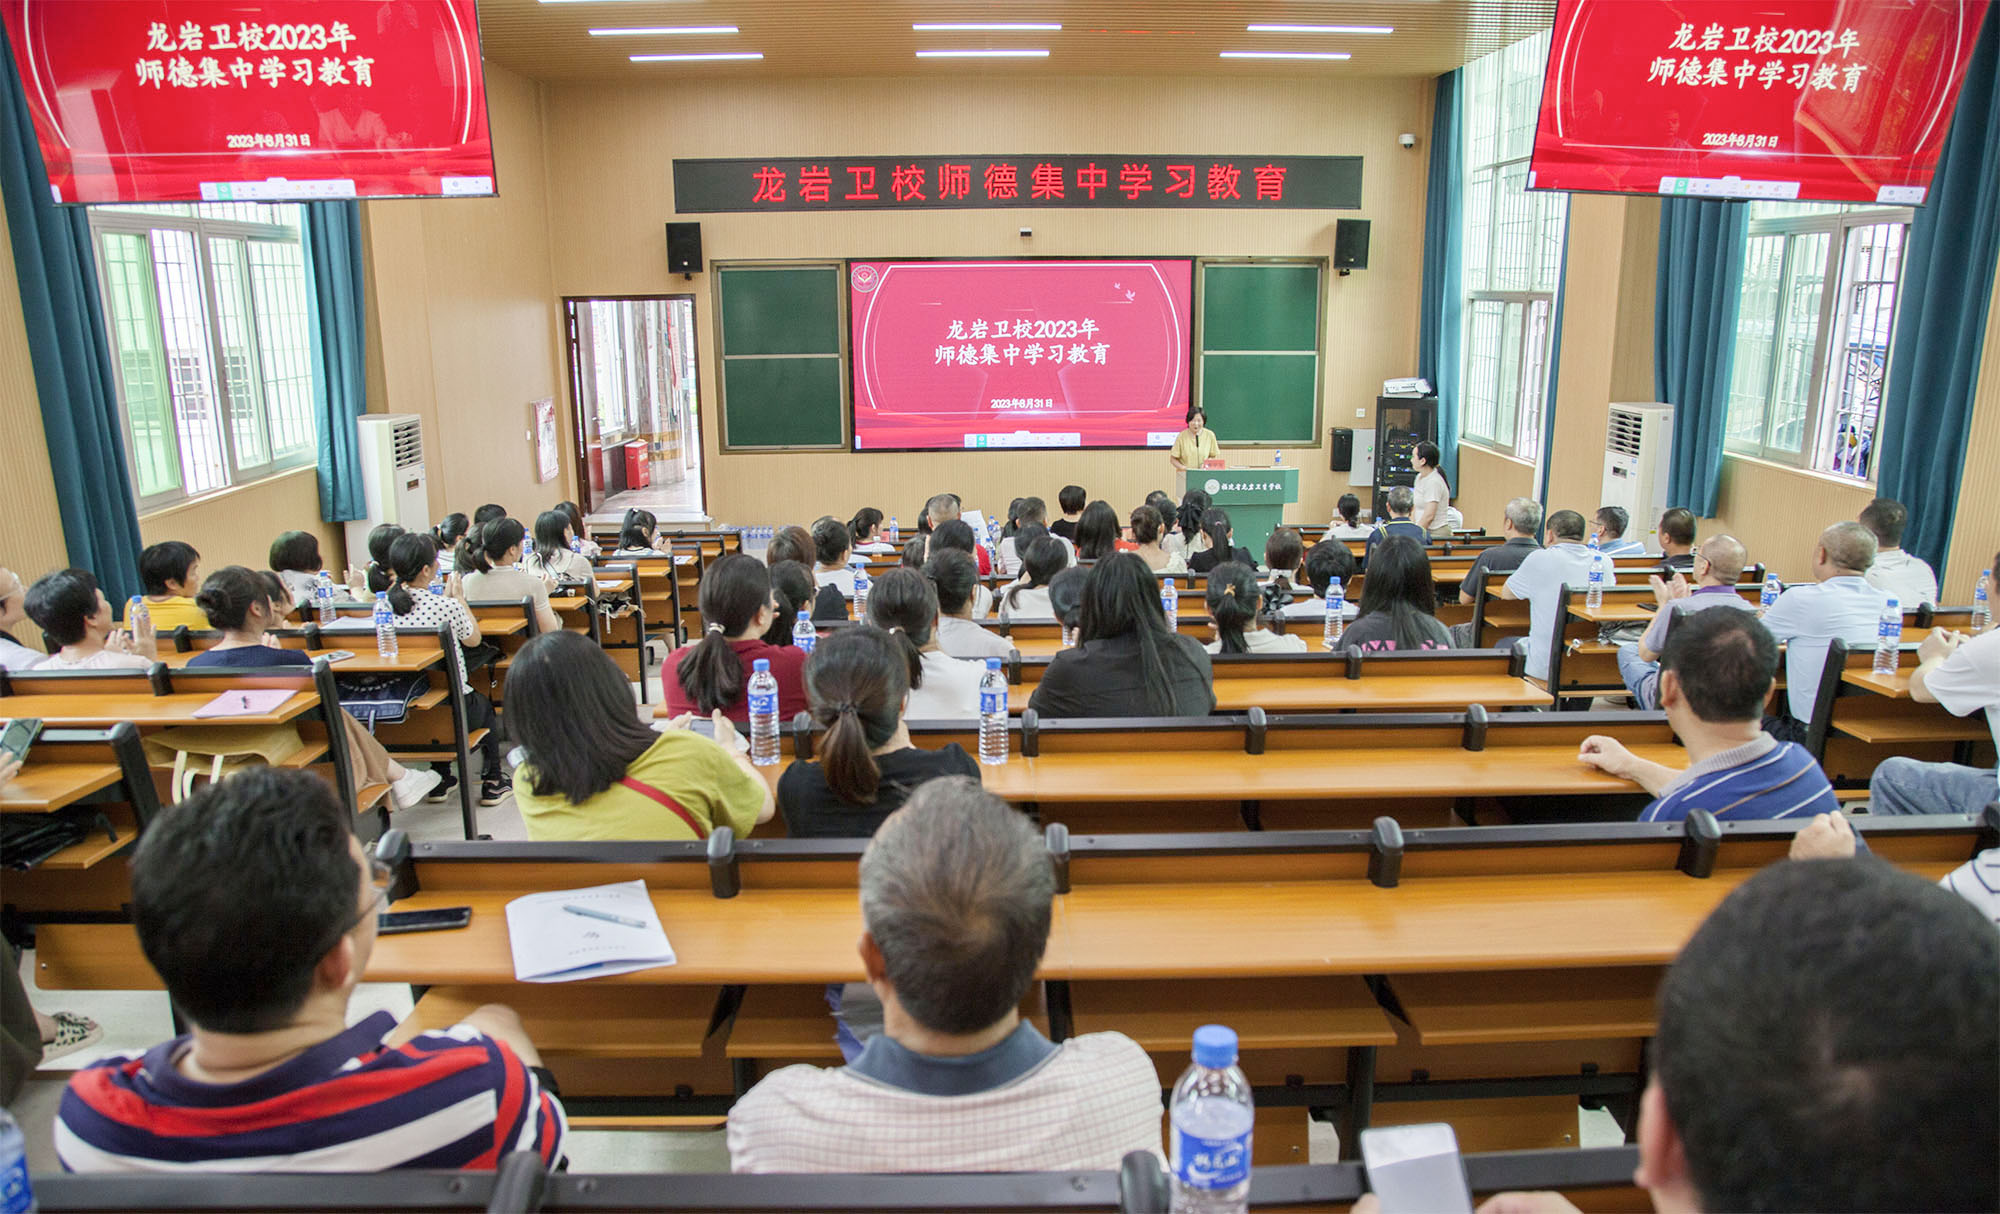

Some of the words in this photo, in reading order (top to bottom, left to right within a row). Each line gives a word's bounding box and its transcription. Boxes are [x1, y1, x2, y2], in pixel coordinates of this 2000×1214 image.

[147, 21, 356, 53] 龙岩卫校2023年
[1669, 23, 1860, 58] 龙岩卫校2023年
[136, 56, 374, 89] 师德集中学习教育
[1648, 57, 1867, 93] 师德集中学习教育
[226, 132, 311, 149] 2023年8月31日
[1701, 132, 1779, 149] 2023年8月31日
[753, 163, 1287, 202] 龙岩卫校师德集中学习教育
[946, 317, 1099, 341] 龙岩卫校2023年
[934, 342, 1111, 366] 师德集中学习教育
[990, 397, 1053, 411] 2023年8月31日
